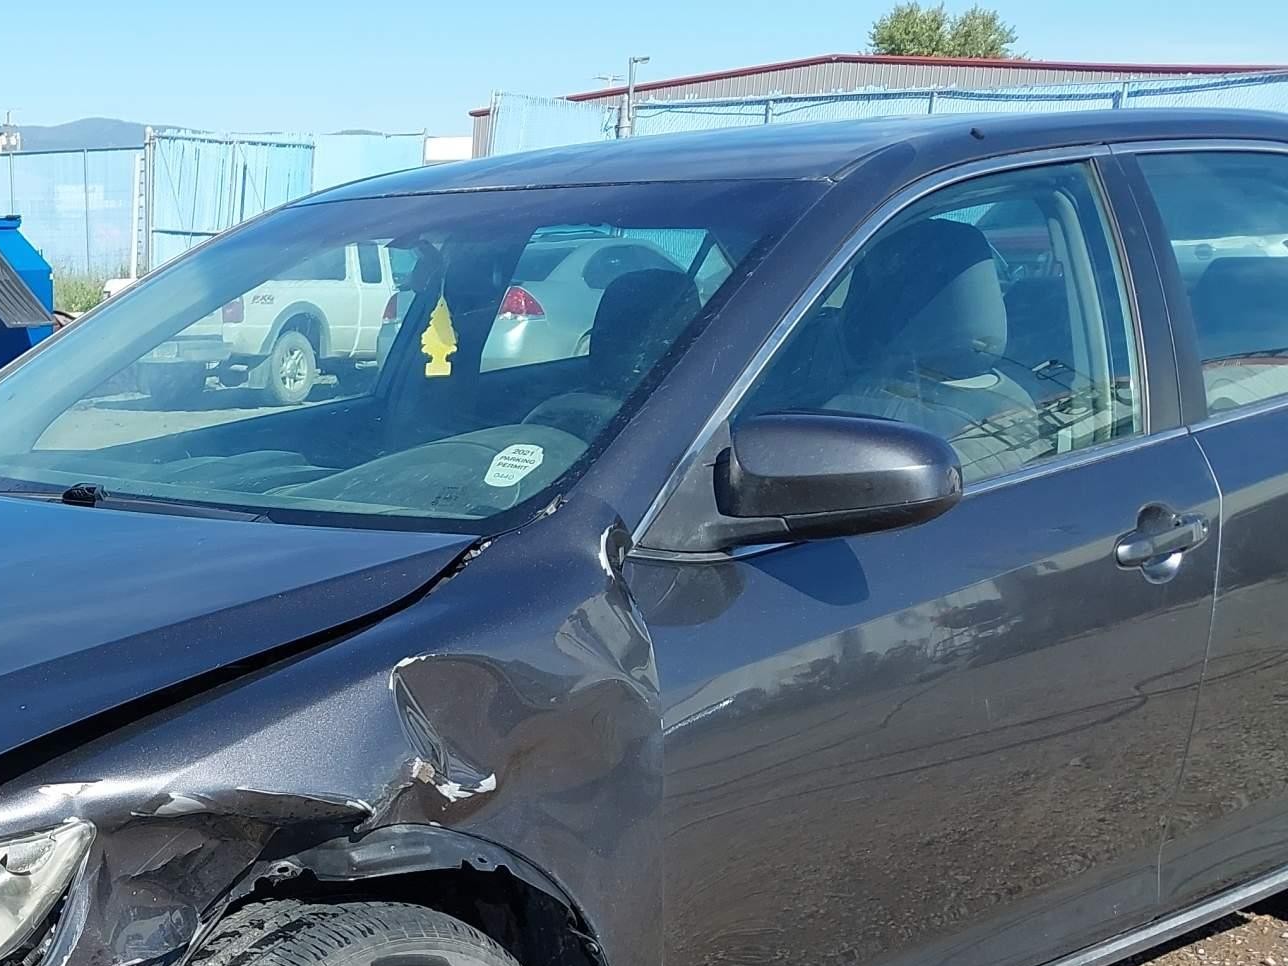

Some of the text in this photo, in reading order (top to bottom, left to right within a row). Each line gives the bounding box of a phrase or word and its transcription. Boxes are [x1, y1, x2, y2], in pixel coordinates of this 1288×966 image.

[512, 448, 535, 456] 2021
[499, 455, 536, 465] PARKING
[496, 461, 529, 471] PERMIT
